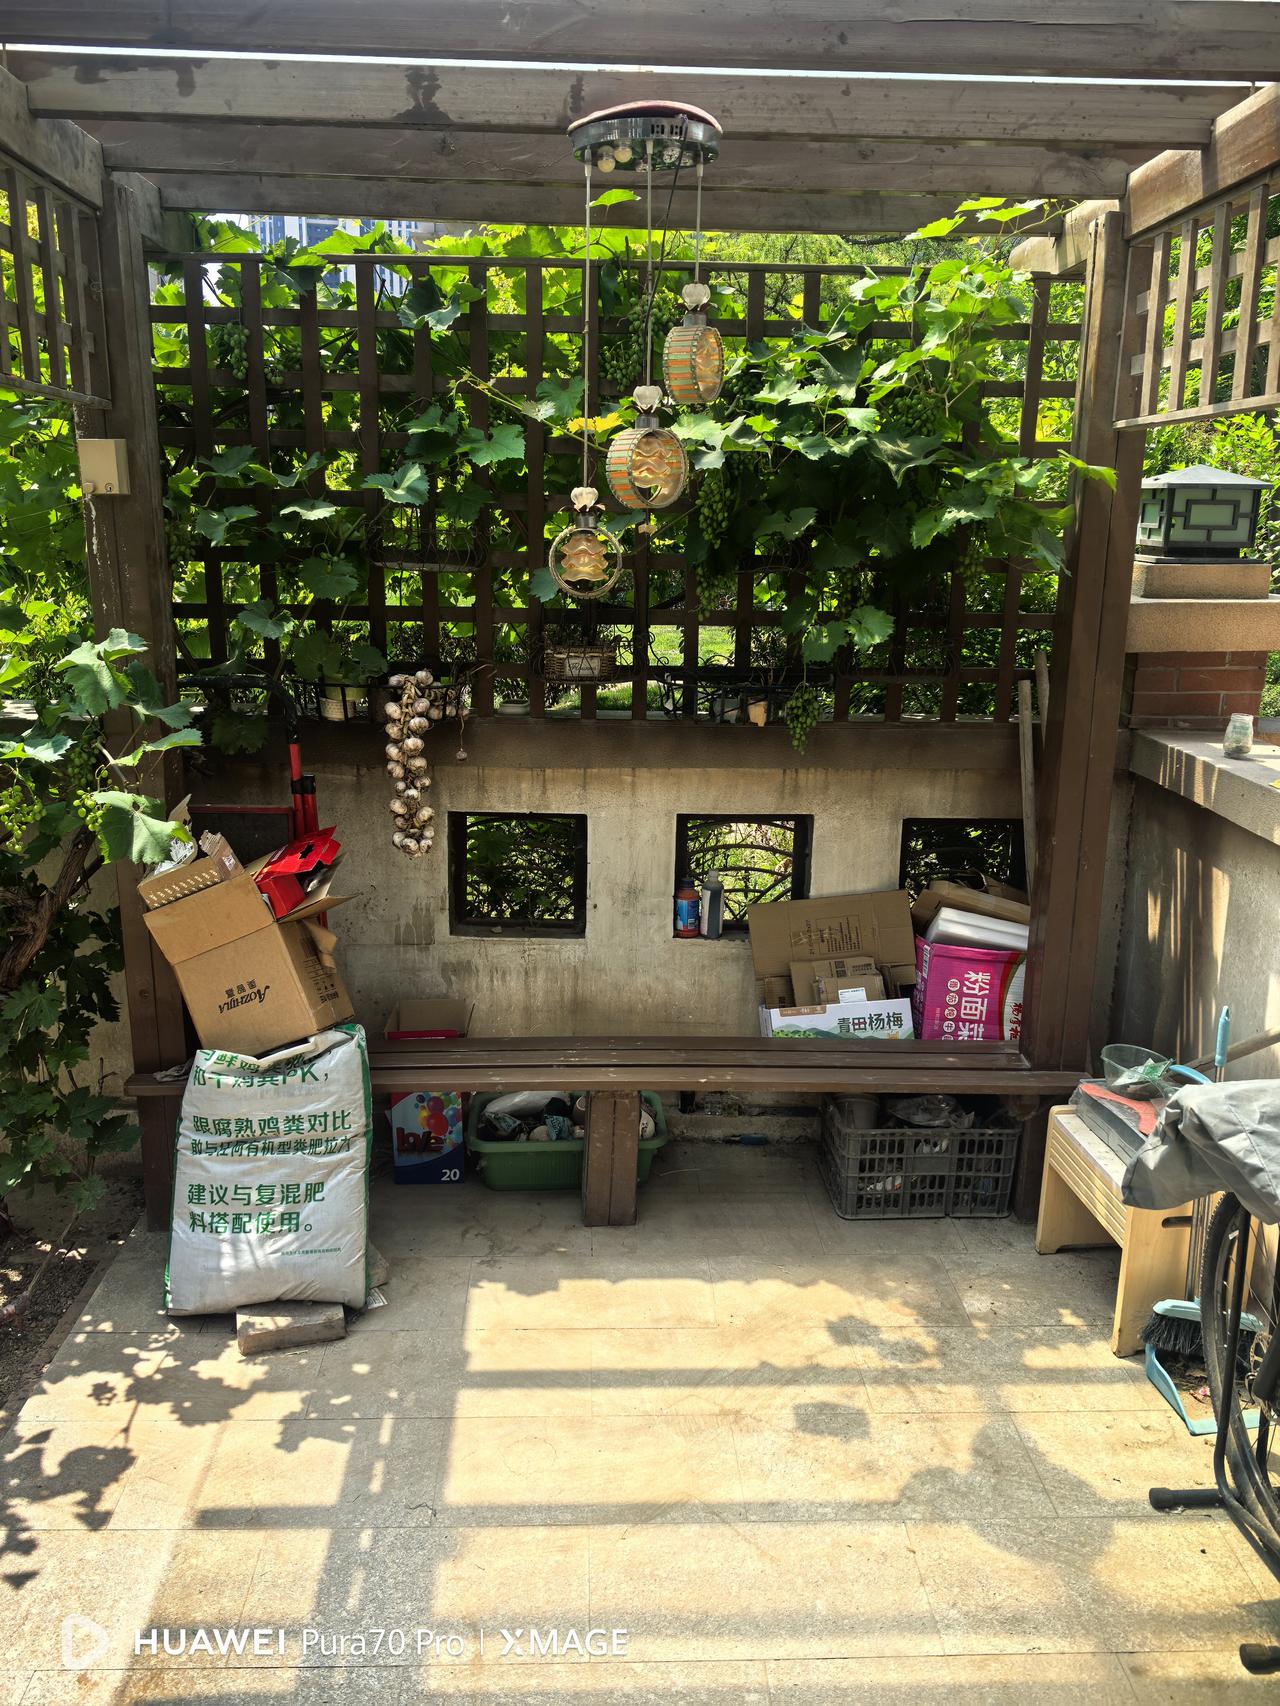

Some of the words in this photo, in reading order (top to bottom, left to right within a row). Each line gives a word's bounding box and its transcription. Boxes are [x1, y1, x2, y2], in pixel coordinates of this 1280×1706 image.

[837, 1011, 903, 1033] 青田杨梅
[193, 1110, 352, 1138] 跟腐熟鸡粪对比
[441, 1169, 460, 1181] 20
[187, 1182, 325, 1206] 建议与复混肥
